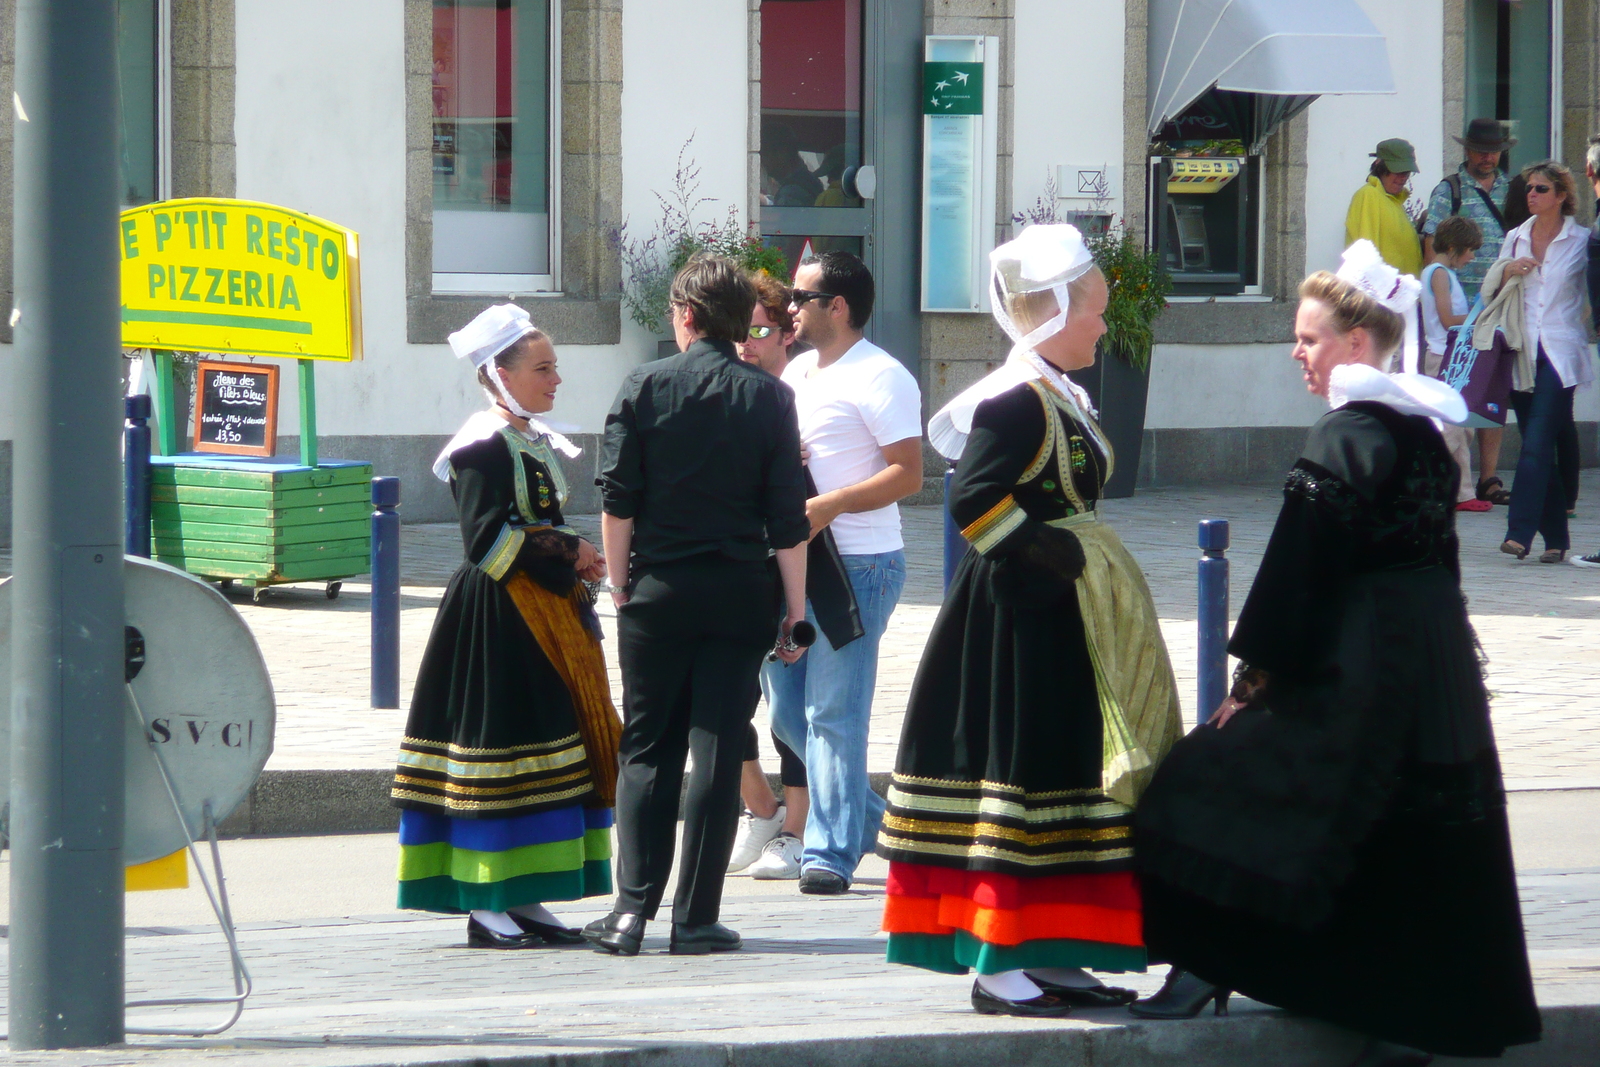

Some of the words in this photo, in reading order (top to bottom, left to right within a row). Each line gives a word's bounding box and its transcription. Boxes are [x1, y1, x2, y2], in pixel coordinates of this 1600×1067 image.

[121, 218, 140, 261] E
[153, 209, 228, 253] P'TIT
[245, 213, 340, 281] RESTO
[147, 263, 302, 312] PIZZERIA
[239, 373, 256, 387] des
[215, 429, 241, 443] 13,50
